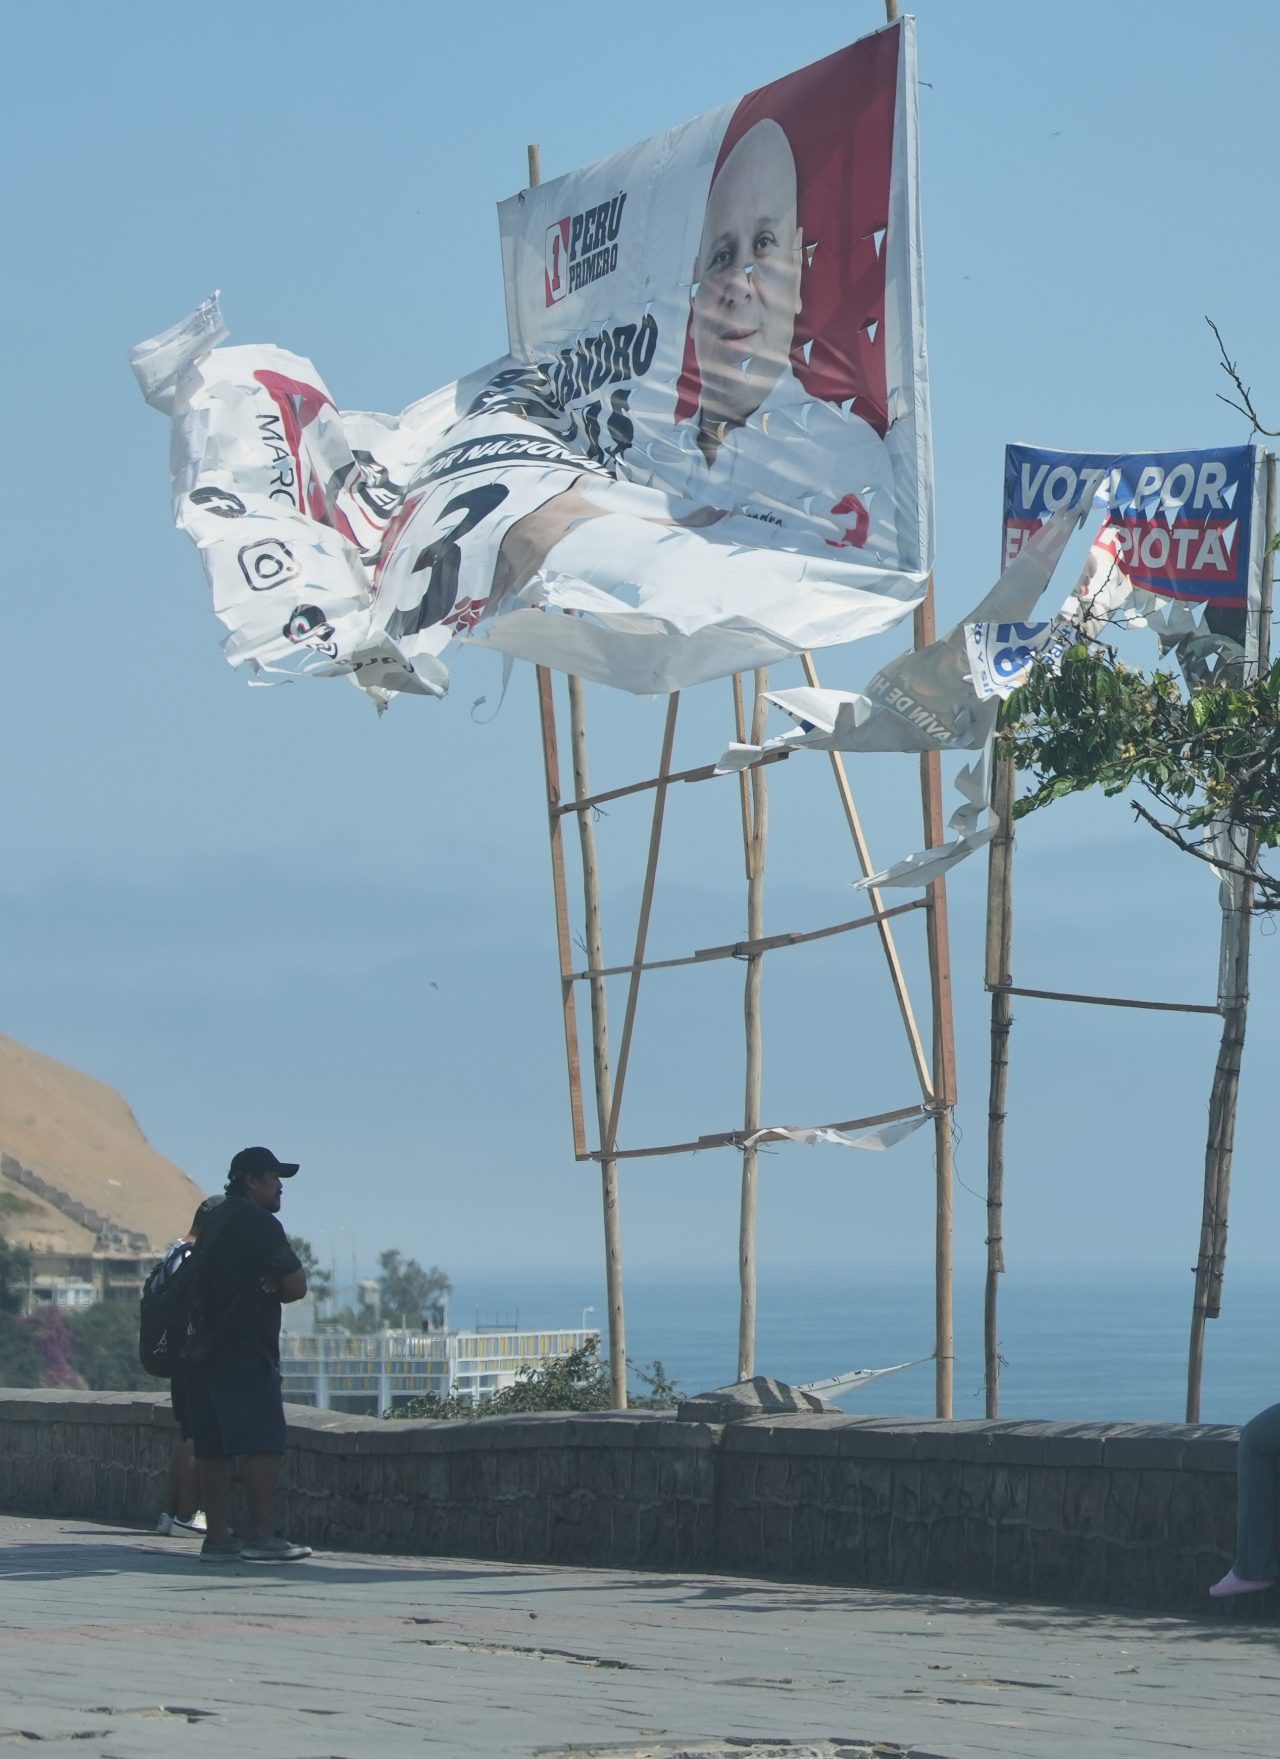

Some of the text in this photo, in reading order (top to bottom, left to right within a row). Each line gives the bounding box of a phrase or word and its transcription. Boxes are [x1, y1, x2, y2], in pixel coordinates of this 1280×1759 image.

[569, 190, 628, 263] PERÚ
[568, 242, 619, 294] PRIMERO
[1135, 462, 1228, 510] POR
